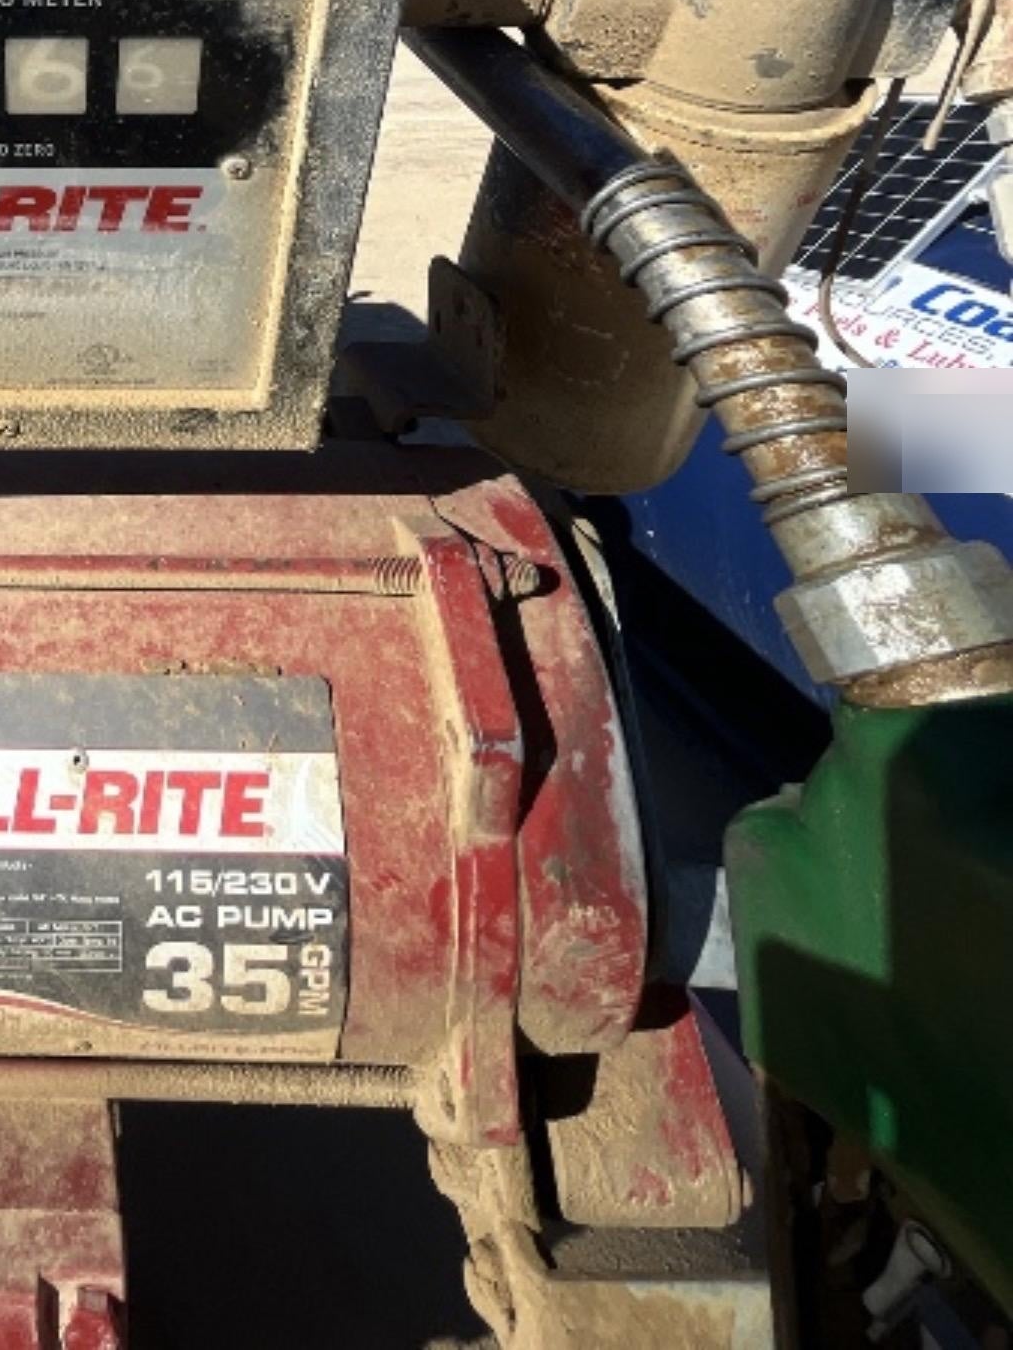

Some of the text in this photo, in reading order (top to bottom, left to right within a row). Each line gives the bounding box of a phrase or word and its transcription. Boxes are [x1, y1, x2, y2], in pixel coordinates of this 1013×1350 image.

[13, 142, 54, 157] ZERO
[145, 868, 298, 897] 115/230
[304, 872, 333, 895] V
[145, 905, 334, 930] AC PUMP
[142, 941, 292, 1015] 35
[298, 943, 333, 1016] GPM
